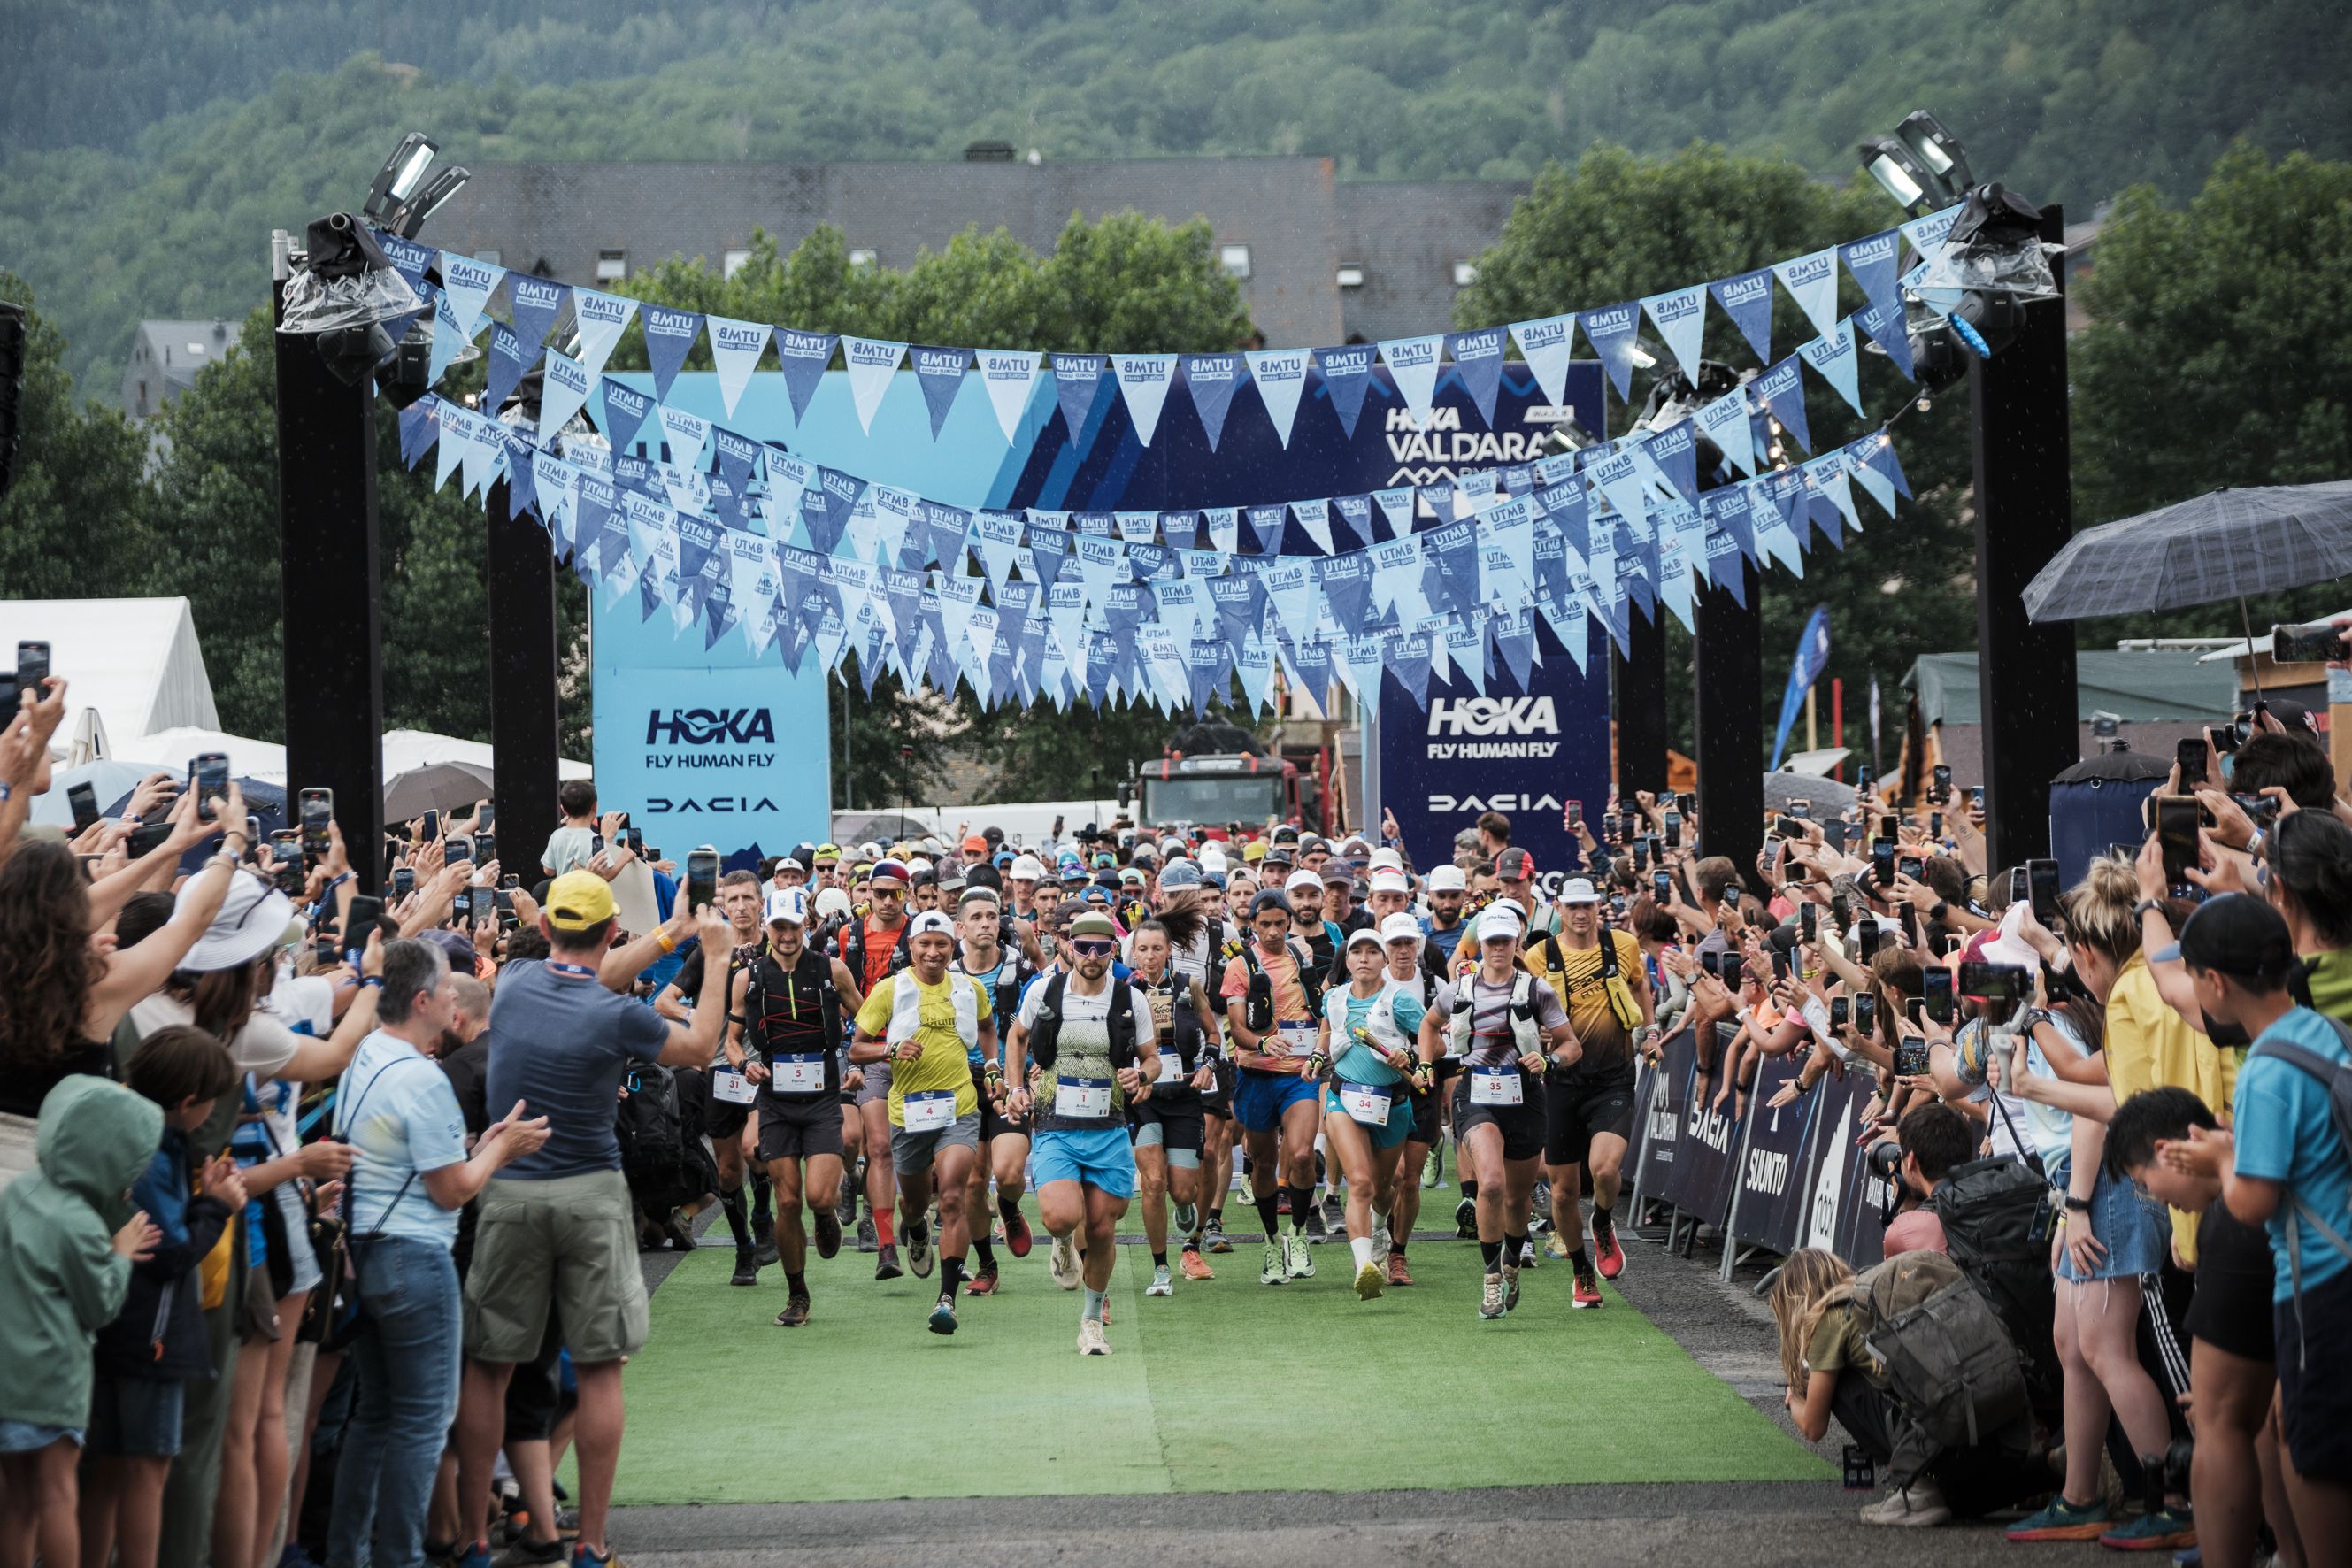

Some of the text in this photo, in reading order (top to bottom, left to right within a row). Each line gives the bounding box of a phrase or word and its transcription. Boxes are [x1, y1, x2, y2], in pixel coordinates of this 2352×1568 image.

[497, 331, 519, 350] UT
[1811, 331, 1847, 358] UTB
[1759, 366, 1795, 394] UTMB
[610, 385, 644, 409] UTMB
[1704, 397, 1739, 423] UTMB
[667, 412, 702, 431] UTMB
[719, 433, 753, 454] UTMB
[1652, 428, 1687, 452] UTMB
[539, 459, 567, 480] UTMB
[772, 454, 805, 475] UTMB
[1597, 455, 1632, 477] UTMB
[584, 480, 613, 498] UTMB
[824, 471, 855, 494] UTMB
[878, 488, 908, 507] UTMB
[1543, 481, 1579, 503] UTMB
[634, 501, 664, 520] UTMB
[931, 507, 962, 525] UTMB
[1490, 503, 1525, 522] UTMB
[682, 521, 712, 539] UTMB
[984, 521, 1014, 536] UTMB
[1434, 526, 1469, 545] UTMB
[734, 538, 763, 553] UTMB
[1032, 532, 1062, 546] UTMB
[785, 549, 817, 567] UTMB
[1083, 542, 1114, 557] UTMB
[1380, 544, 1413, 560] UTMB
[835, 564, 866, 579] UTMB
[1324, 557, 1358, 573] UTMB
[887, 573, 919, 588] UTMB
[1269, 568, 1303, 584] UTMB
[941, 580, 973, 594] UTMB
[1001, 588, 1026, 600] TMB
[1161, 585, 1192, 597] UTMB
[1215, 581, 1248, 594] UTMB
[1446, 629, 1476, 642] UTMB
[1347, 645, 1376, 657] UTMB
[1395, 640, 1426, 652] UTMB
[1427, 696, 1559, 735] HOKA
[646, 708, 775, 744] HOKA
[1427, 742, 1558, 759] FLY HUMAN FLY
[646, 754, 774, 768] FLY HUMAN FLY
[647, 797, 780, 812] DACIA
[1428, 794, 1563, 811] DACIA
[1581, 980, 1605, 999] RTIV
[1489, 1082, 1502, 1091] 35
[1359, 1100, 1371, 1109] 34
[1747, 1148, 1787, 1196] SUUNTO
